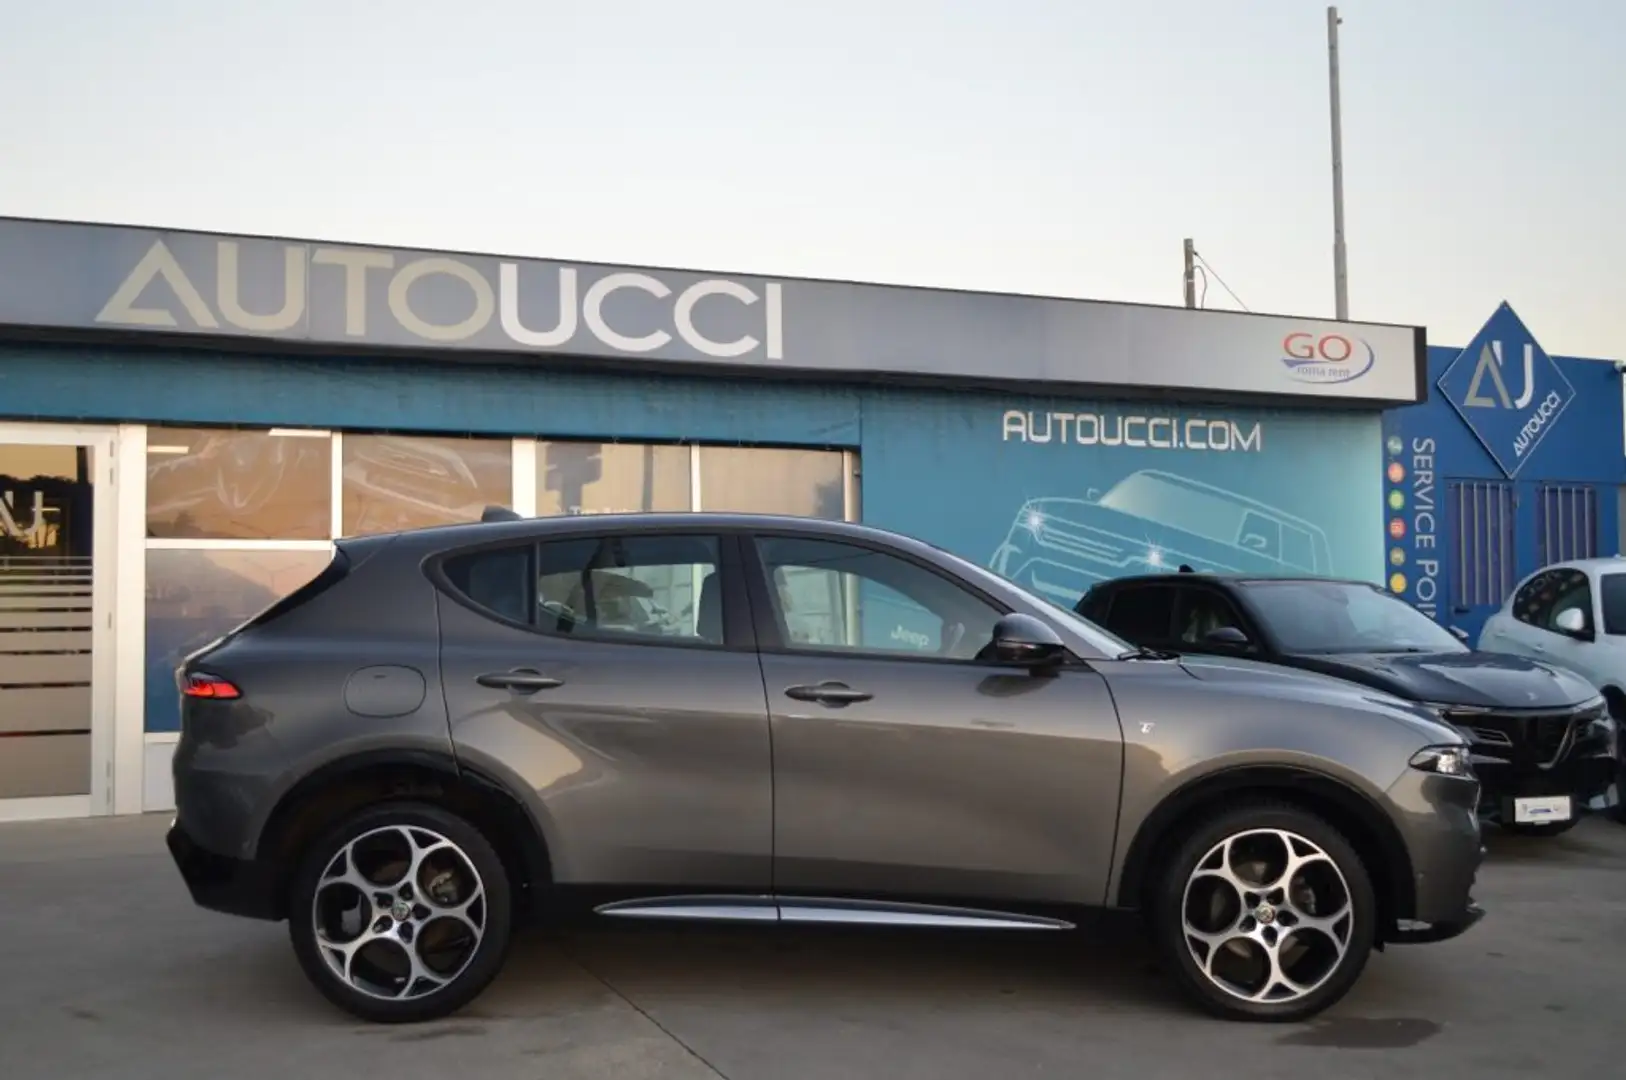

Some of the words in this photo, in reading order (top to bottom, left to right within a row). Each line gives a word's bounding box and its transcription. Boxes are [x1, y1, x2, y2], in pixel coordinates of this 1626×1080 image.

[95, 238, 784, 360] AUTOUCCI
[1283, 332, 1352, 362] GO
[1002, 410, 1262, 452] AUTOUCCI.COM
[1513, 389, 1562, 457] AUTOUCCI
[1412, 437, 1437, 549] SERVICE
[891, 625, 930, 651] Jeep
